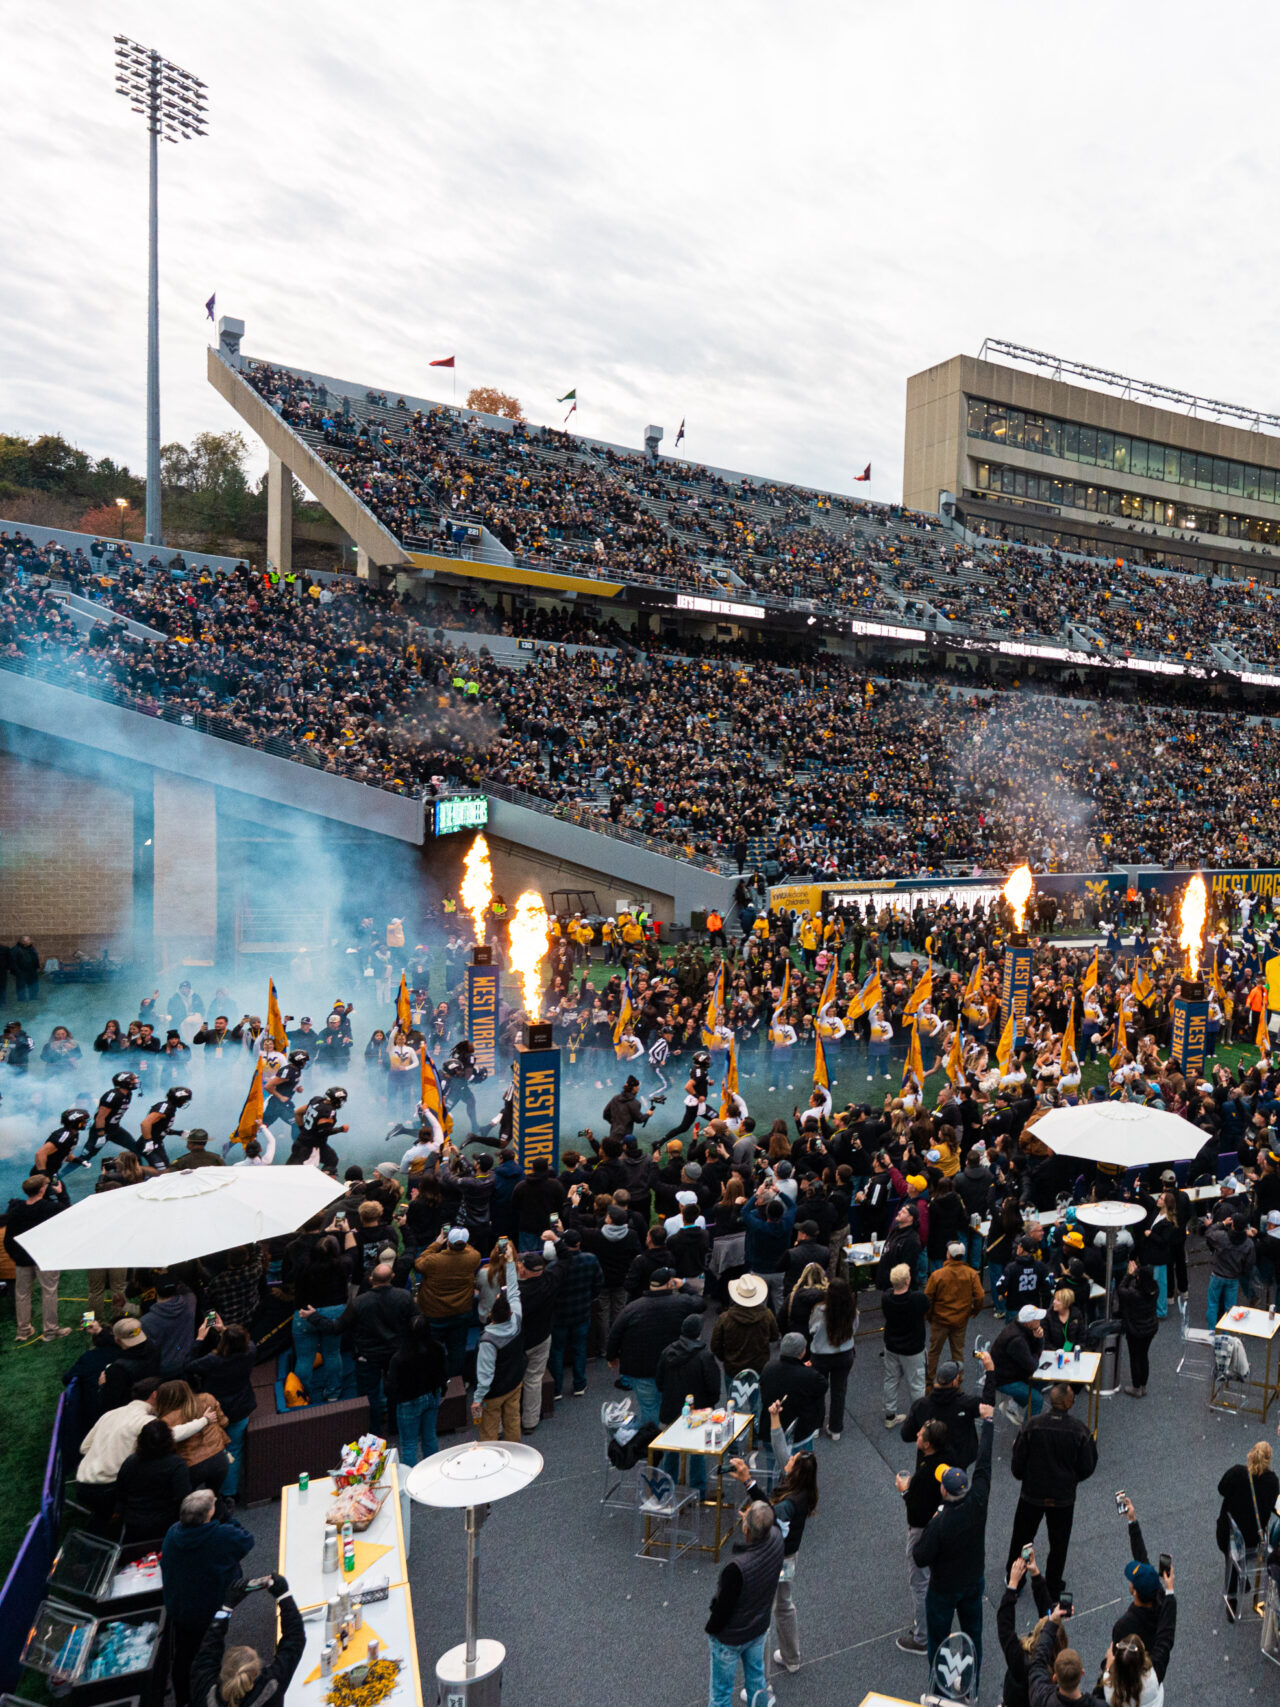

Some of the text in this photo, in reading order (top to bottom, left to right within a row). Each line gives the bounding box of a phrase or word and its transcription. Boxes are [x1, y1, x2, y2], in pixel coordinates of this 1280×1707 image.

[1211, 874, 1249, 900] WEST
[1014, 957, 1031, 987] WEST
[472, 976, 496, 1012] WEST
[1187, 1015, 1207, 1051] WEST
[525, 1069, 555, 1118] WEST
[524, 1122, 554, 1176] VIRG
[1019, 1274, 1037, 1292] 23
